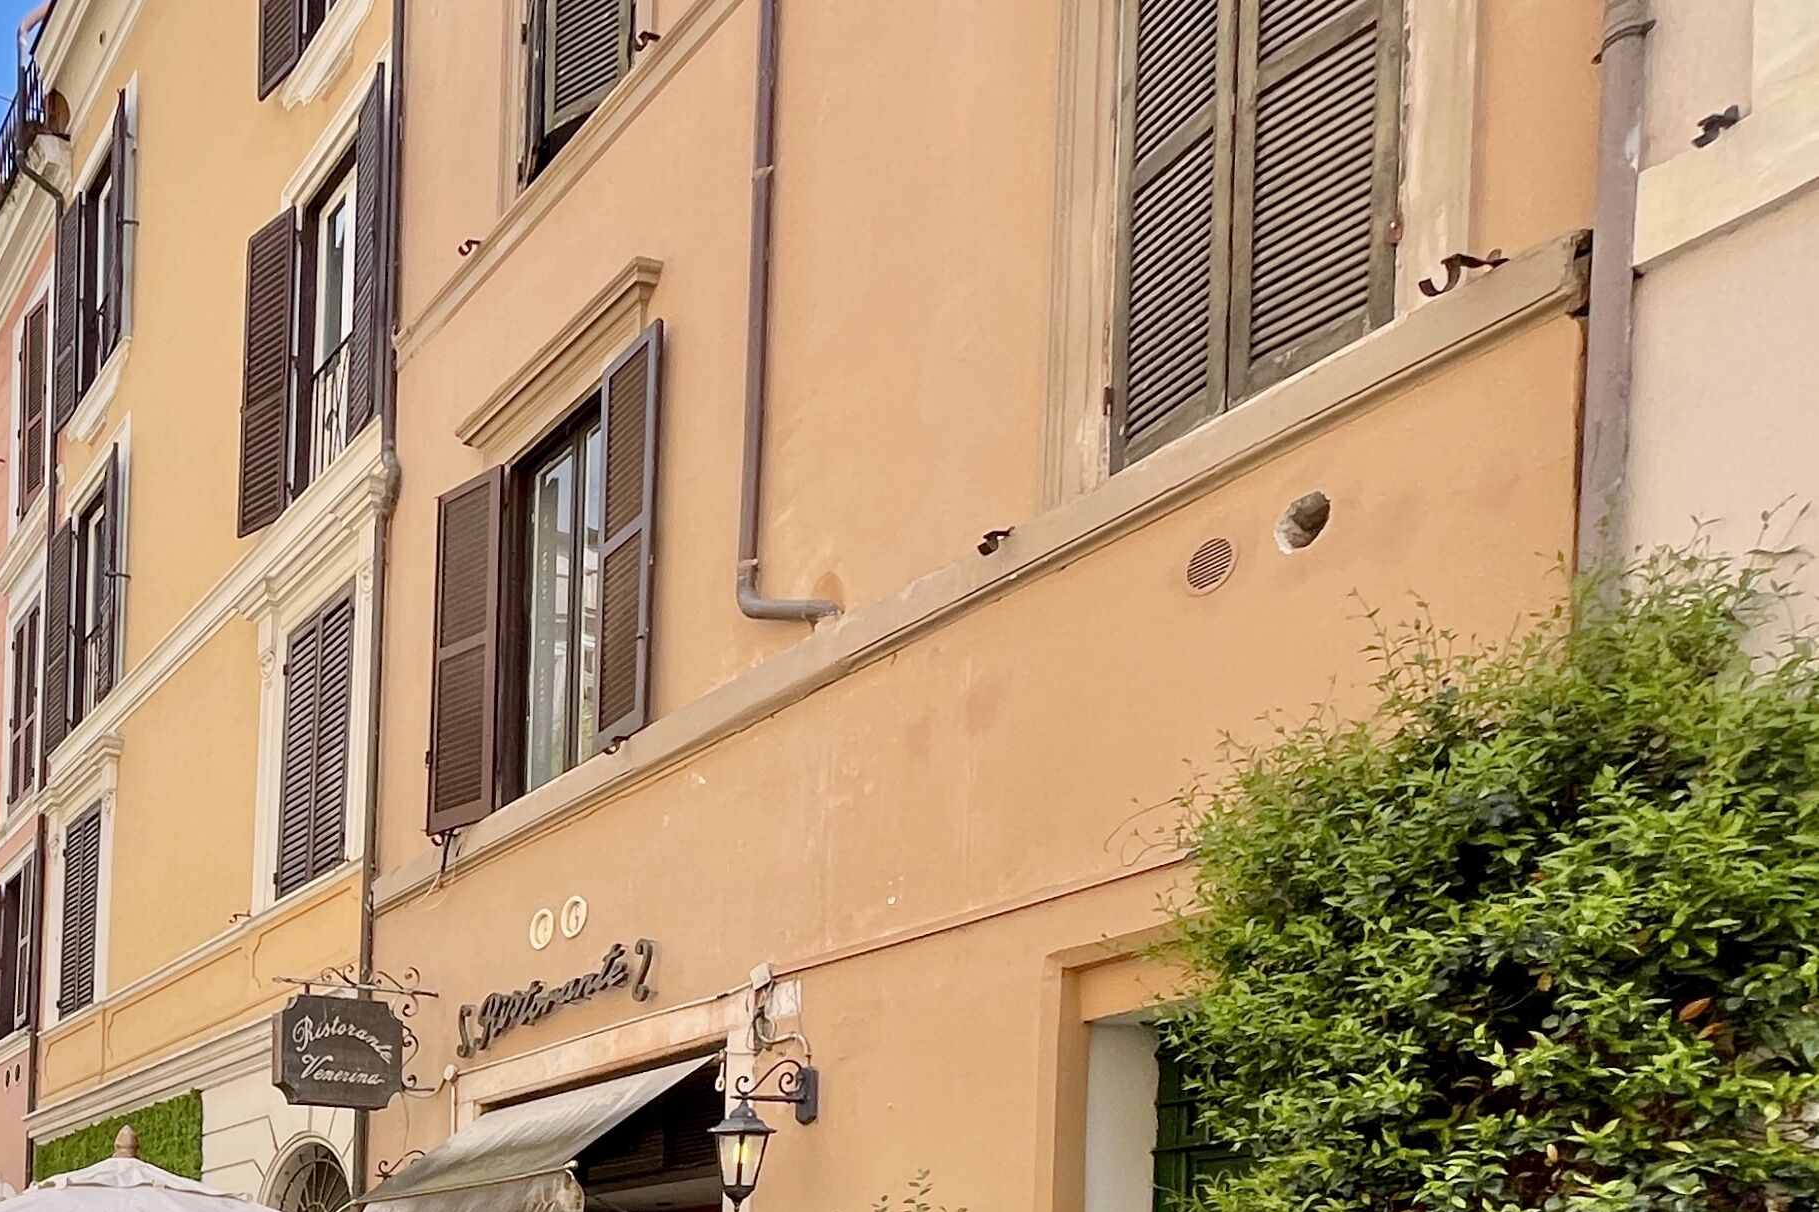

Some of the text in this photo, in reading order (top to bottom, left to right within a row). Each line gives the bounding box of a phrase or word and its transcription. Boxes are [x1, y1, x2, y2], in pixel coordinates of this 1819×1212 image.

[473, 943, 630, 1050] Ristorante
[292, 1014, 393, 1064] Ristorante
[300, 1054, 385, 1085] Venerina
